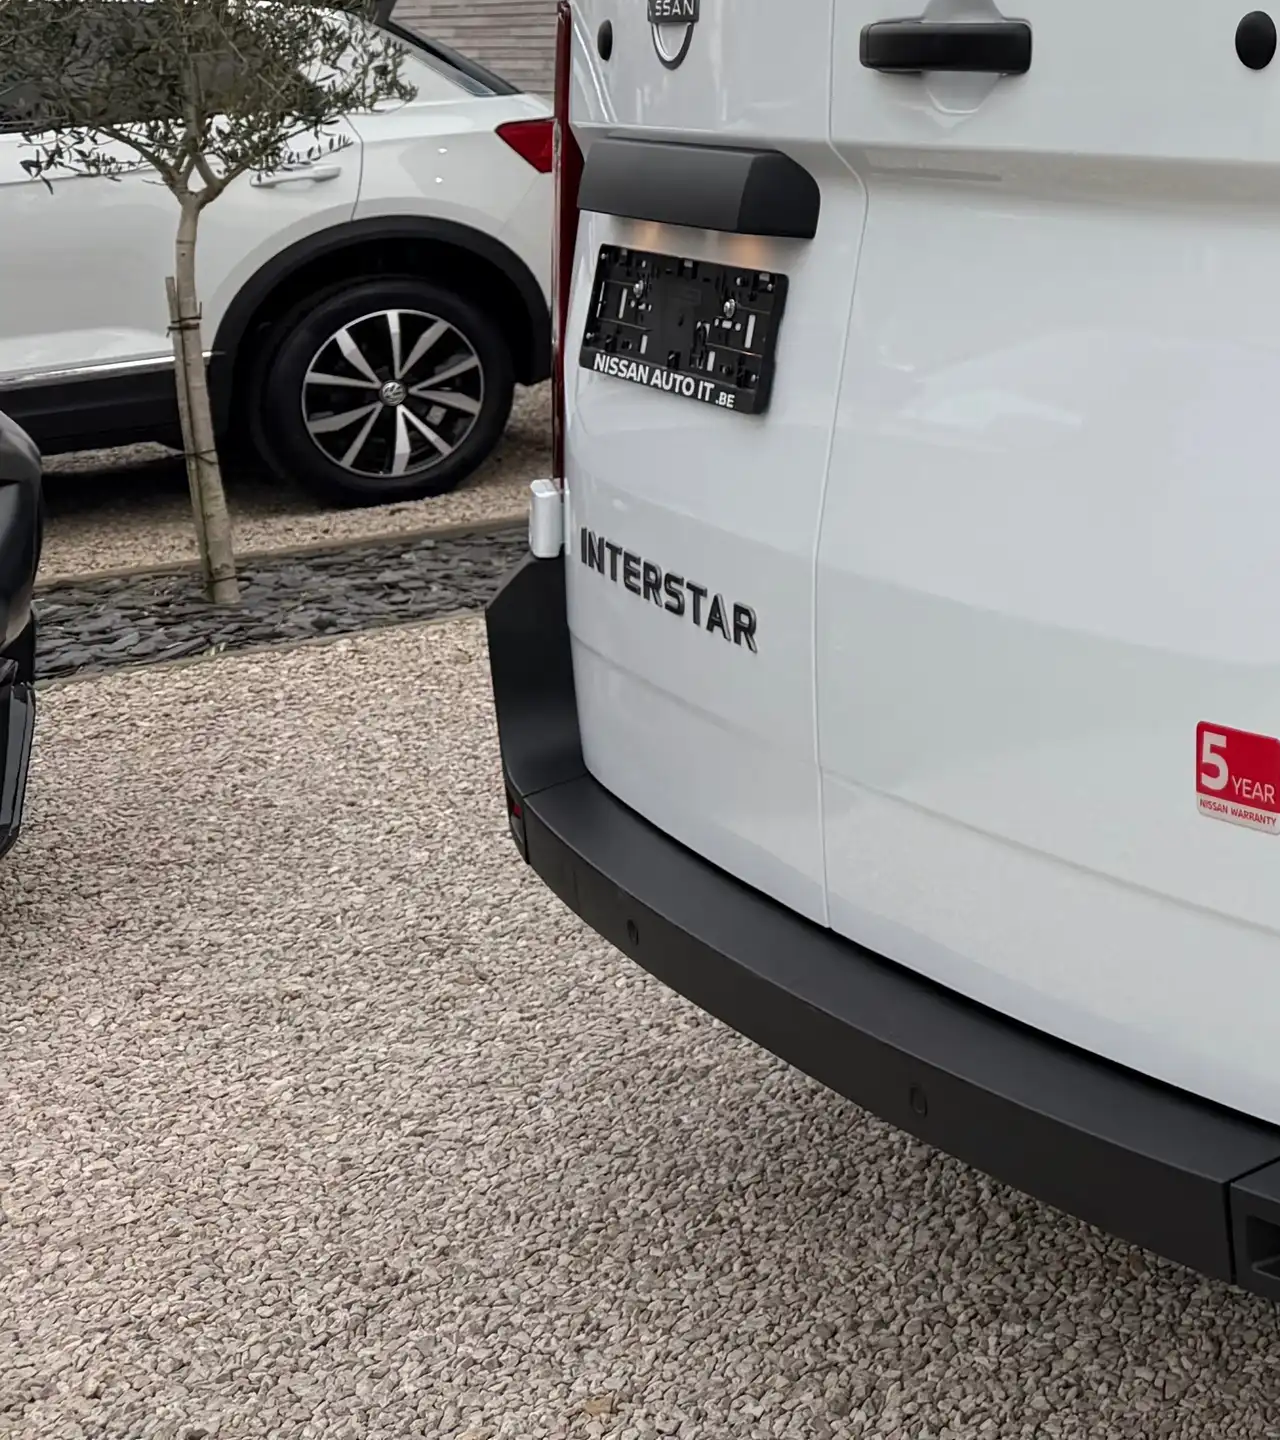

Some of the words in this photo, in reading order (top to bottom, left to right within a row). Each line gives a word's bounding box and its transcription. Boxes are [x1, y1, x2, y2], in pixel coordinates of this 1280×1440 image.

[592, 353, 650, 384] NISSAN
[650, 368, 695, 397] AUTO
[697, 380, 716, 401] IT
[715, 391, 736, 409] .BE
[580, 526, 758, 654] INTERSTAR
[1201, 730, 1229, 791] 5
[1231, 774, 1276, 805] YEAR
[1199, 798, 1229, 815] NISSAN
[1230, 806, 1278, 827] WARRANTY
